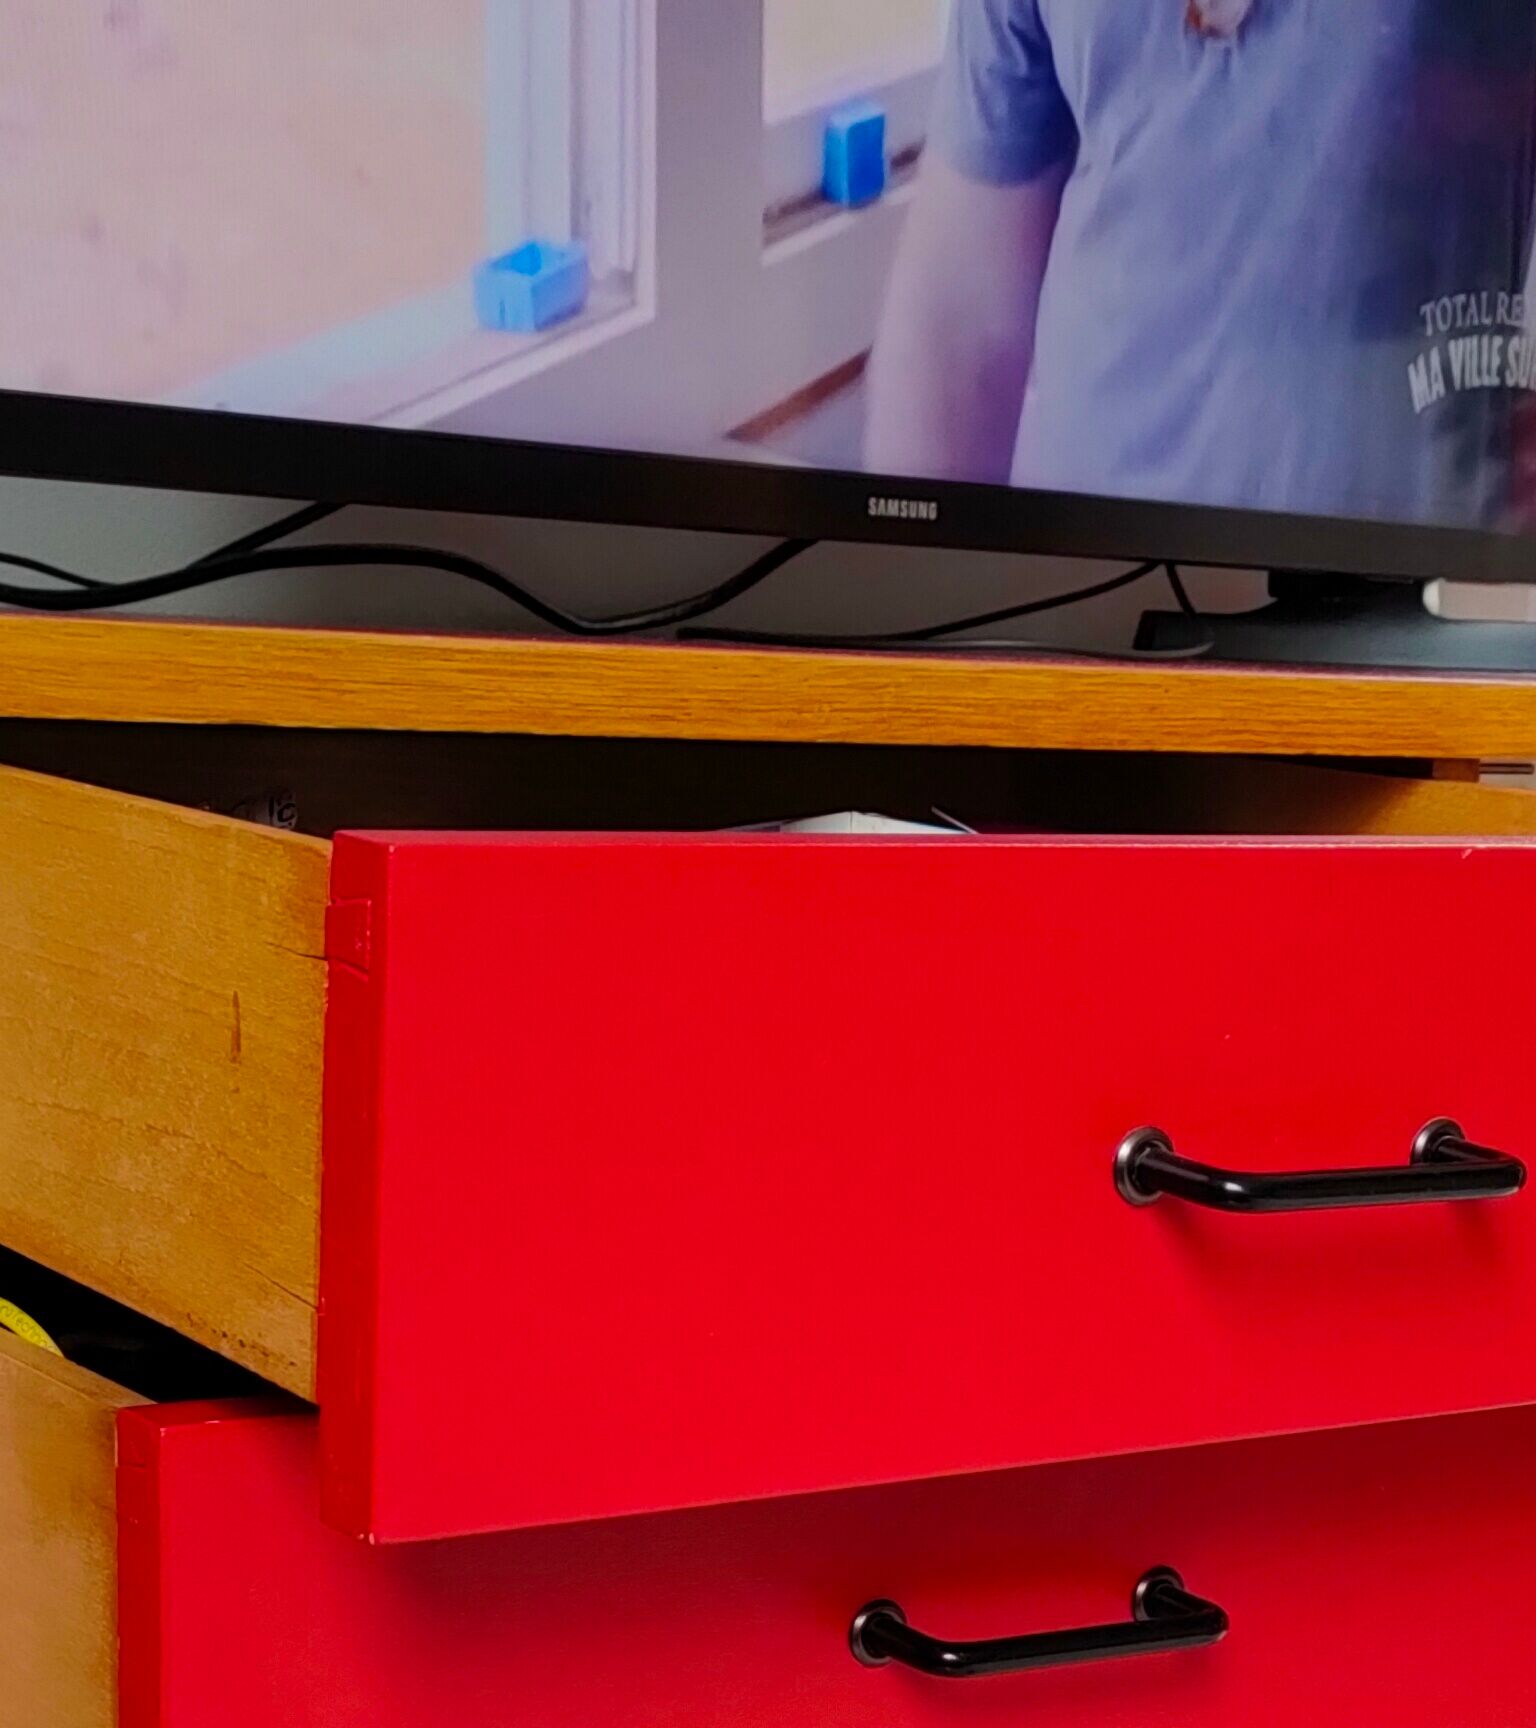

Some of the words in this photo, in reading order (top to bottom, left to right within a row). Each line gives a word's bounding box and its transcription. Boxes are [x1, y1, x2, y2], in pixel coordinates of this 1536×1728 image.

[1420, 292, 1492, 336] TOTAL
[1408, 346, 1446, 415] MA
[1448, 334, 1502, 392] VILLE
[868, 497, 939, 521] SAMSUNG
